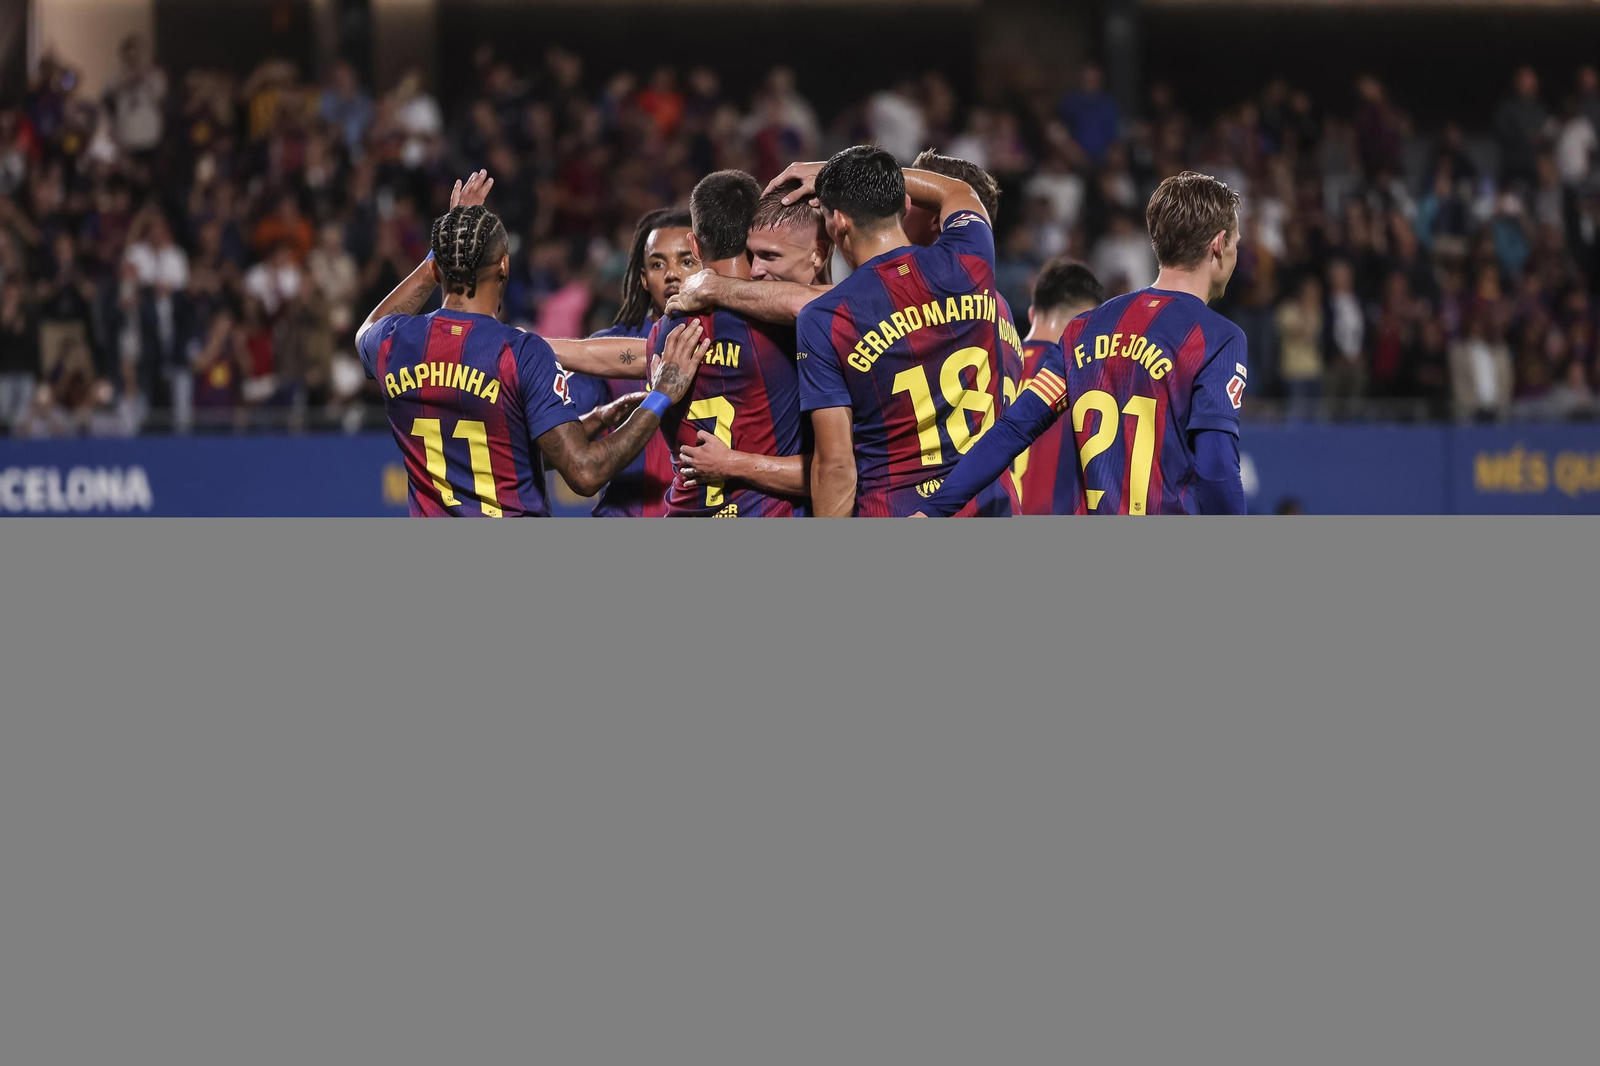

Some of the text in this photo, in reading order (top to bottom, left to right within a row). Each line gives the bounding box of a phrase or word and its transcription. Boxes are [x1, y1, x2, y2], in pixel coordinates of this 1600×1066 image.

[385, 361, 501, 404] RAPHINHA
[892, 346, 995, 466] 18
[411, 418, 502, 517] 11
[1072, 389, 1157, 516] 21
